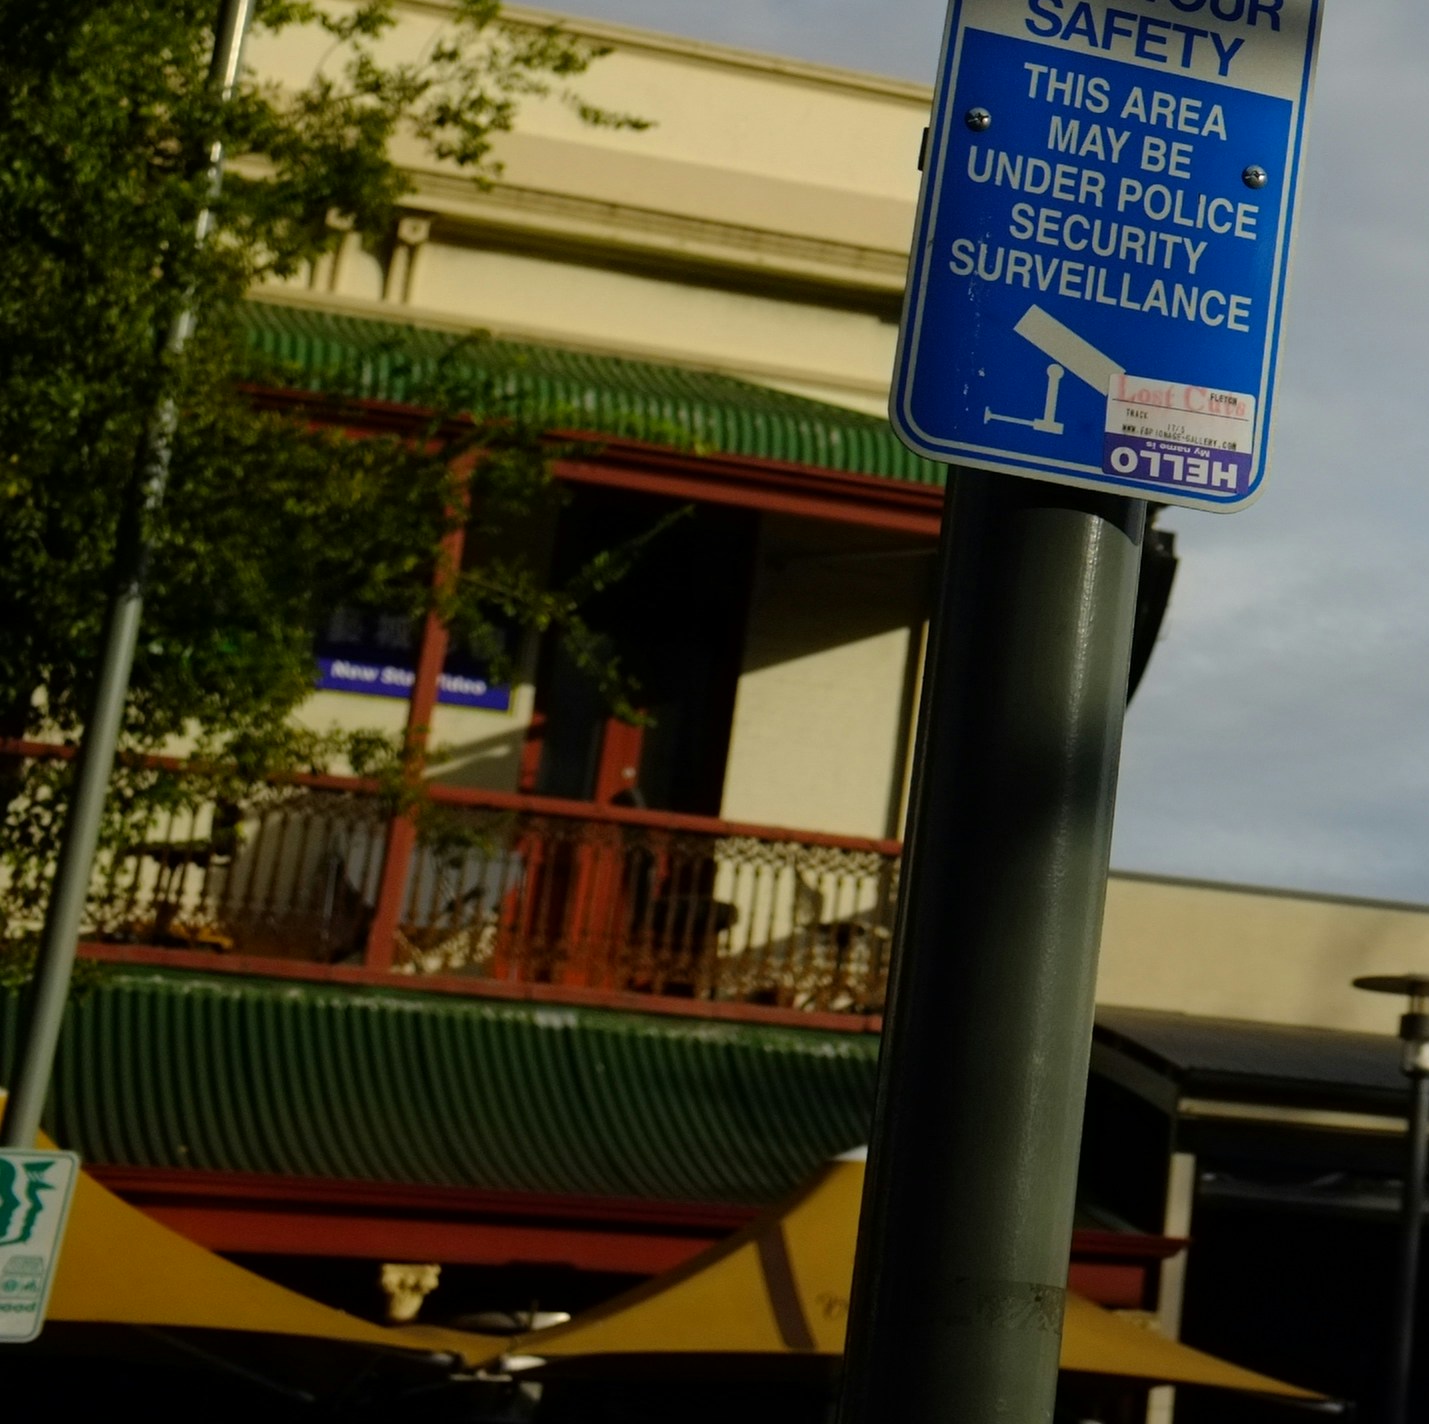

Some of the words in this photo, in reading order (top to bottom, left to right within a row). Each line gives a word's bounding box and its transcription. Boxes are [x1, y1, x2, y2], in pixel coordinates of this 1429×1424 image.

[1023, 62, 1110, 113] THIS
[1120, 87, 1227, 141] AREA
[1047, 116, 1131, 164] MAY
[1141, 142, 1194, 179] BE
[967, 145, 1106, 207] UNDER
[1117, 178, 1260, 240] POLICE
[1009, 202, 1208, 275] SECURITY
[949, 238, 1253, 333] SURVEILLANCE
[1117, 375, 1175, 407] Lost
[1110, 446, 1238, 489] HELLO
[1146, 441, 1157, 449] is
[1160, 443, 1191, 454] name
[1194, 448, 1210, 458] My
